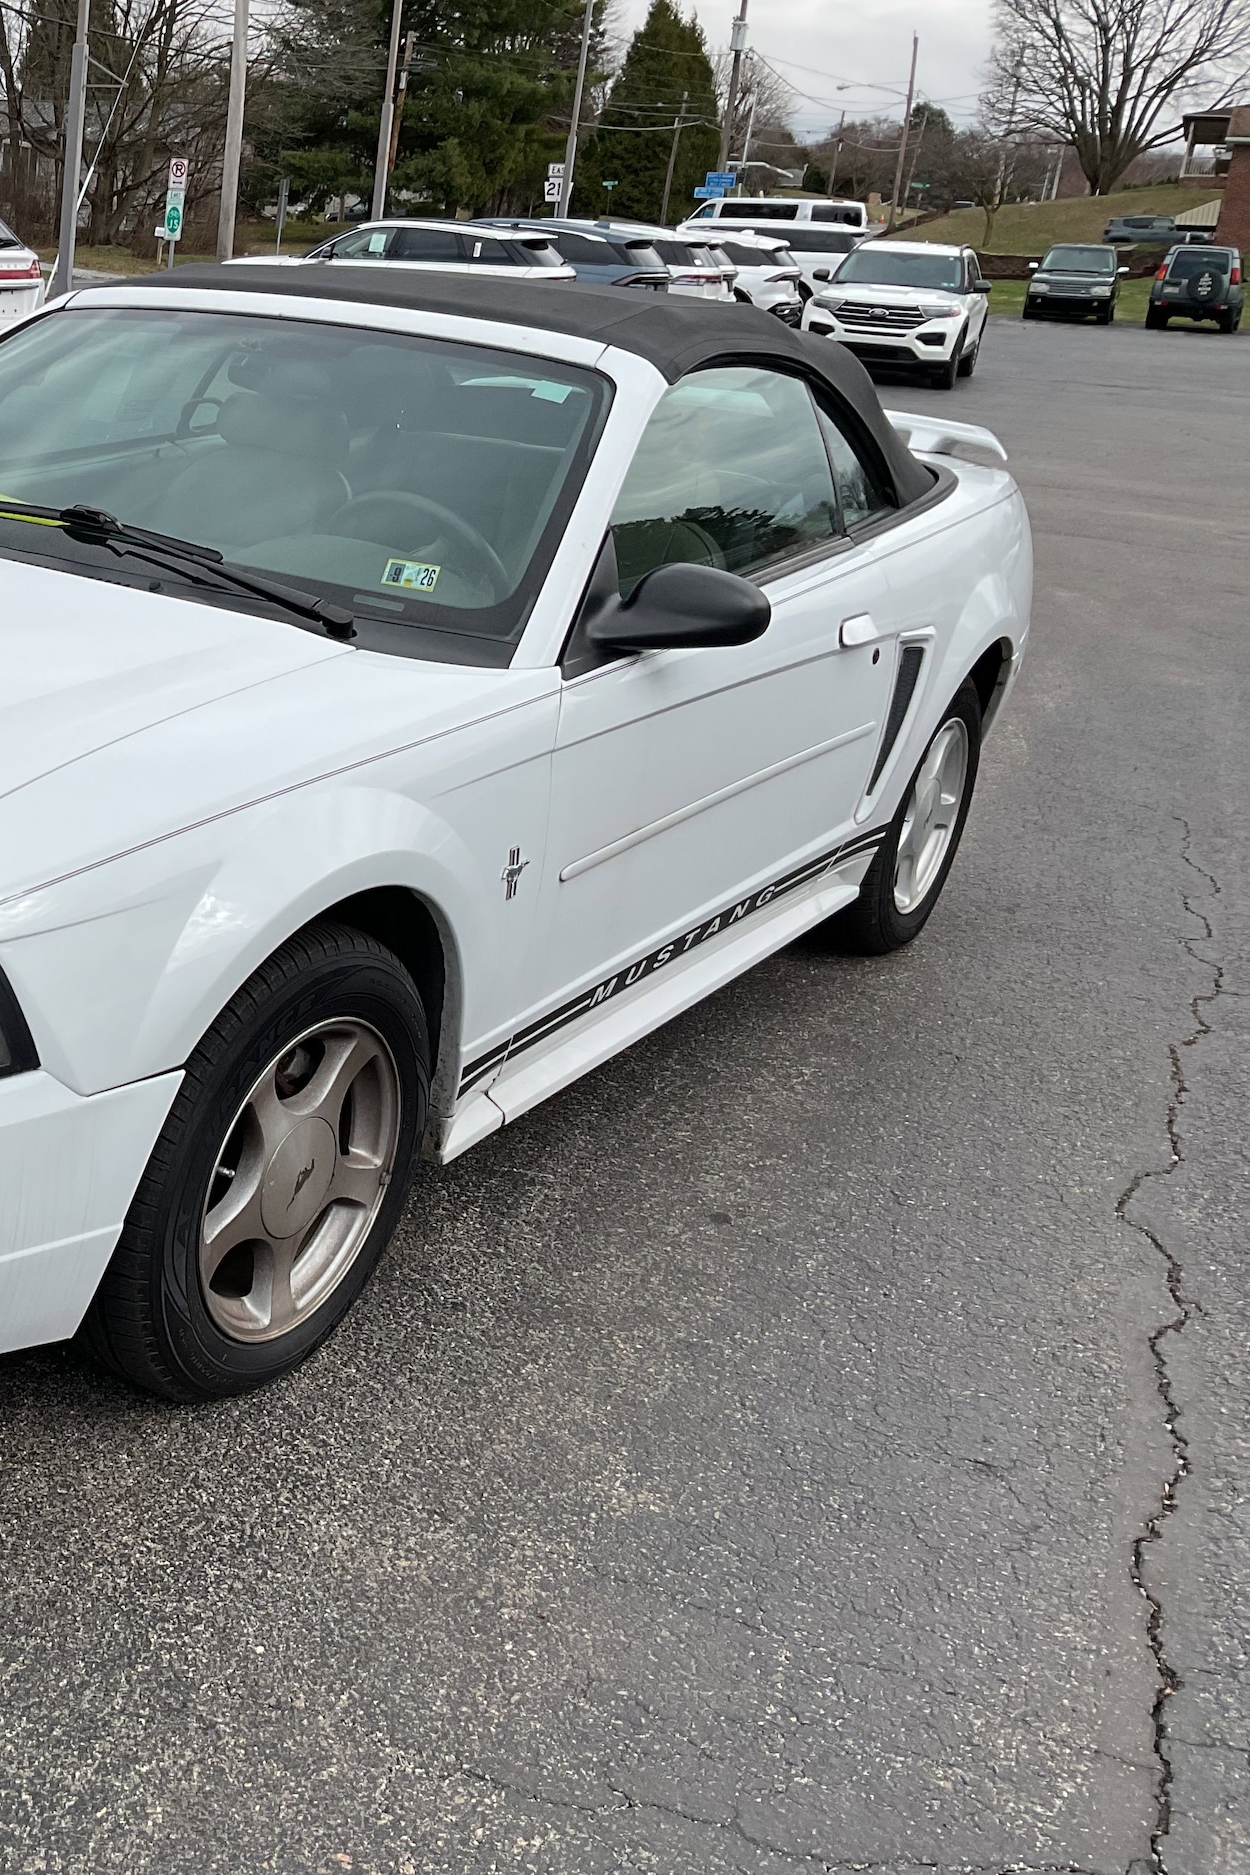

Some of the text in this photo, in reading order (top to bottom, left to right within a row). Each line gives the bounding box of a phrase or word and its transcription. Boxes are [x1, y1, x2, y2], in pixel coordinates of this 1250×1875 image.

[552, 165, 565, 174] EAS
[547, 182, 561, 196] 21
[420, 568, 437, 587] 26
[589, 885, 776, 1008] MUSTANG
